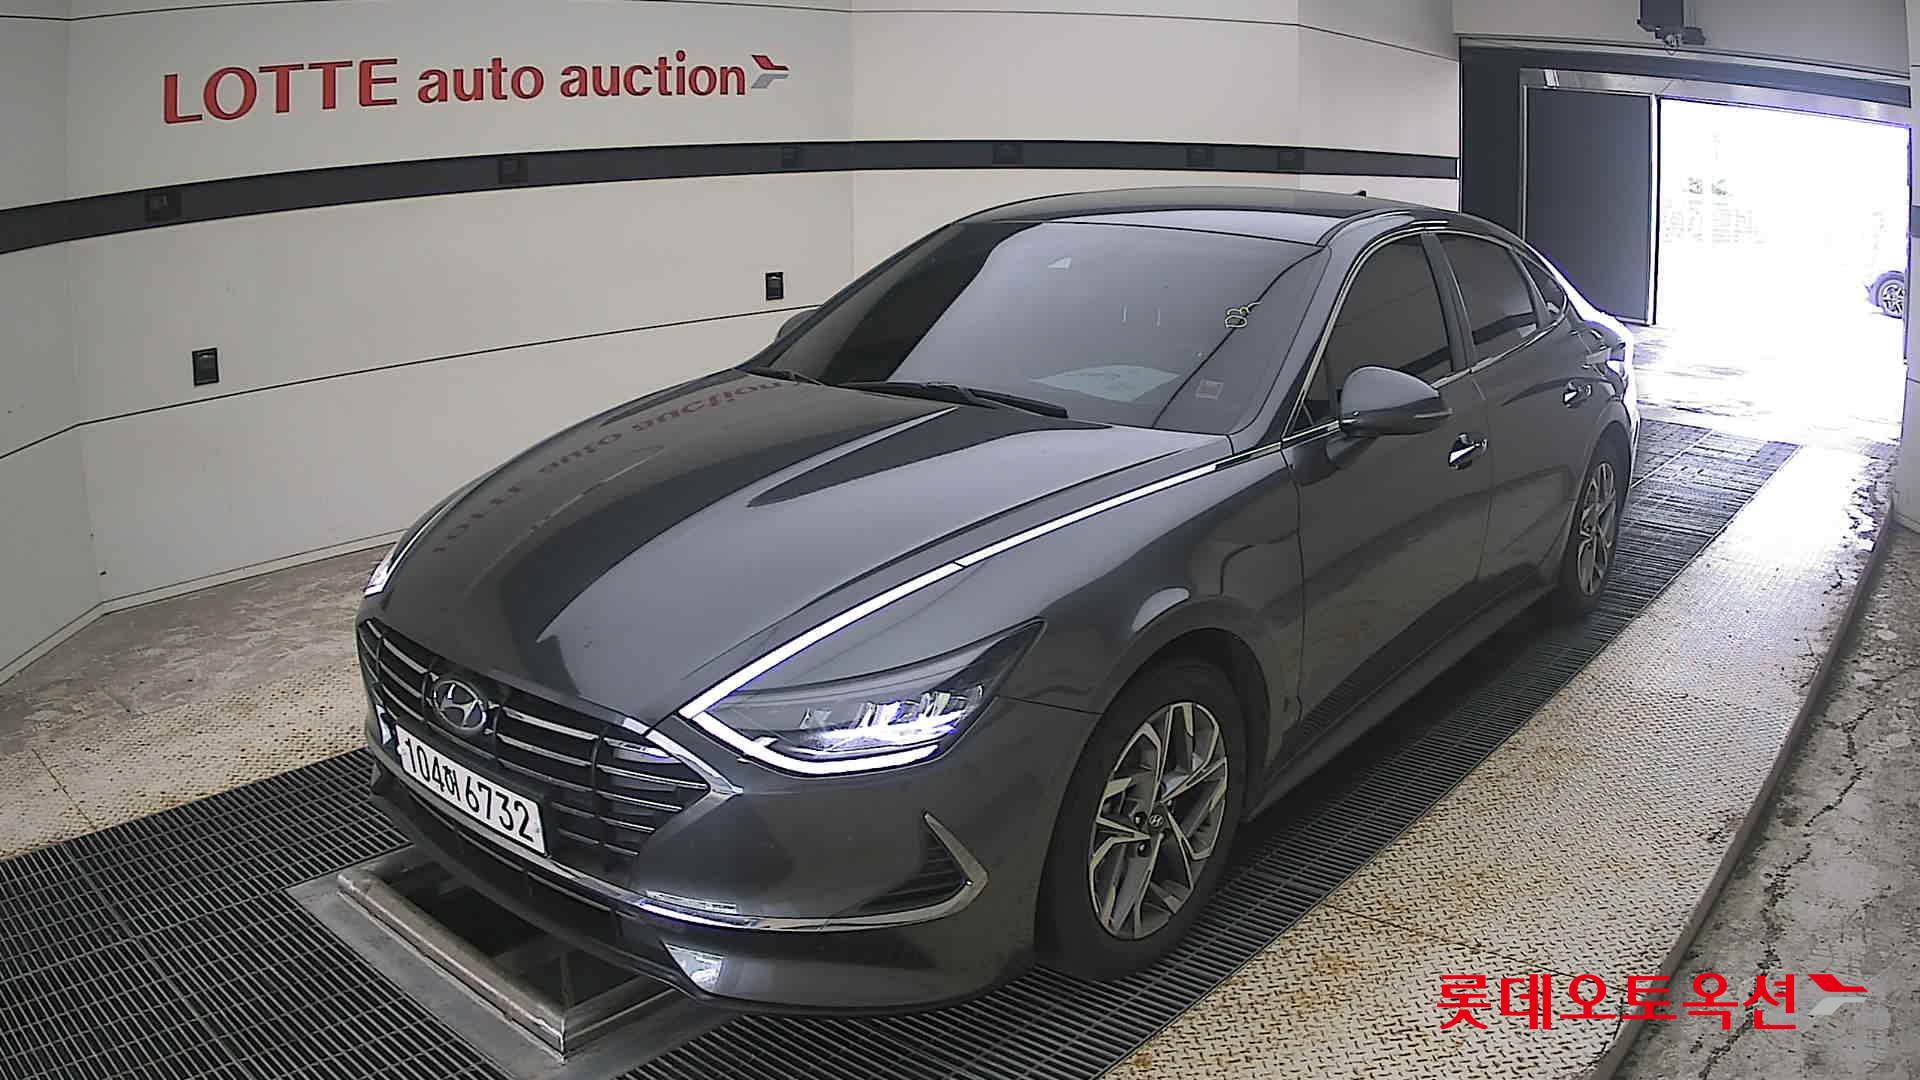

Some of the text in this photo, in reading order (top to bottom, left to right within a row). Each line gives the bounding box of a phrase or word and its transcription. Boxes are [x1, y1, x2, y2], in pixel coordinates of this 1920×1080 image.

[163, 50, 746, 124] LOTTE auto auction
[465, 775, 534, 843] 6732
